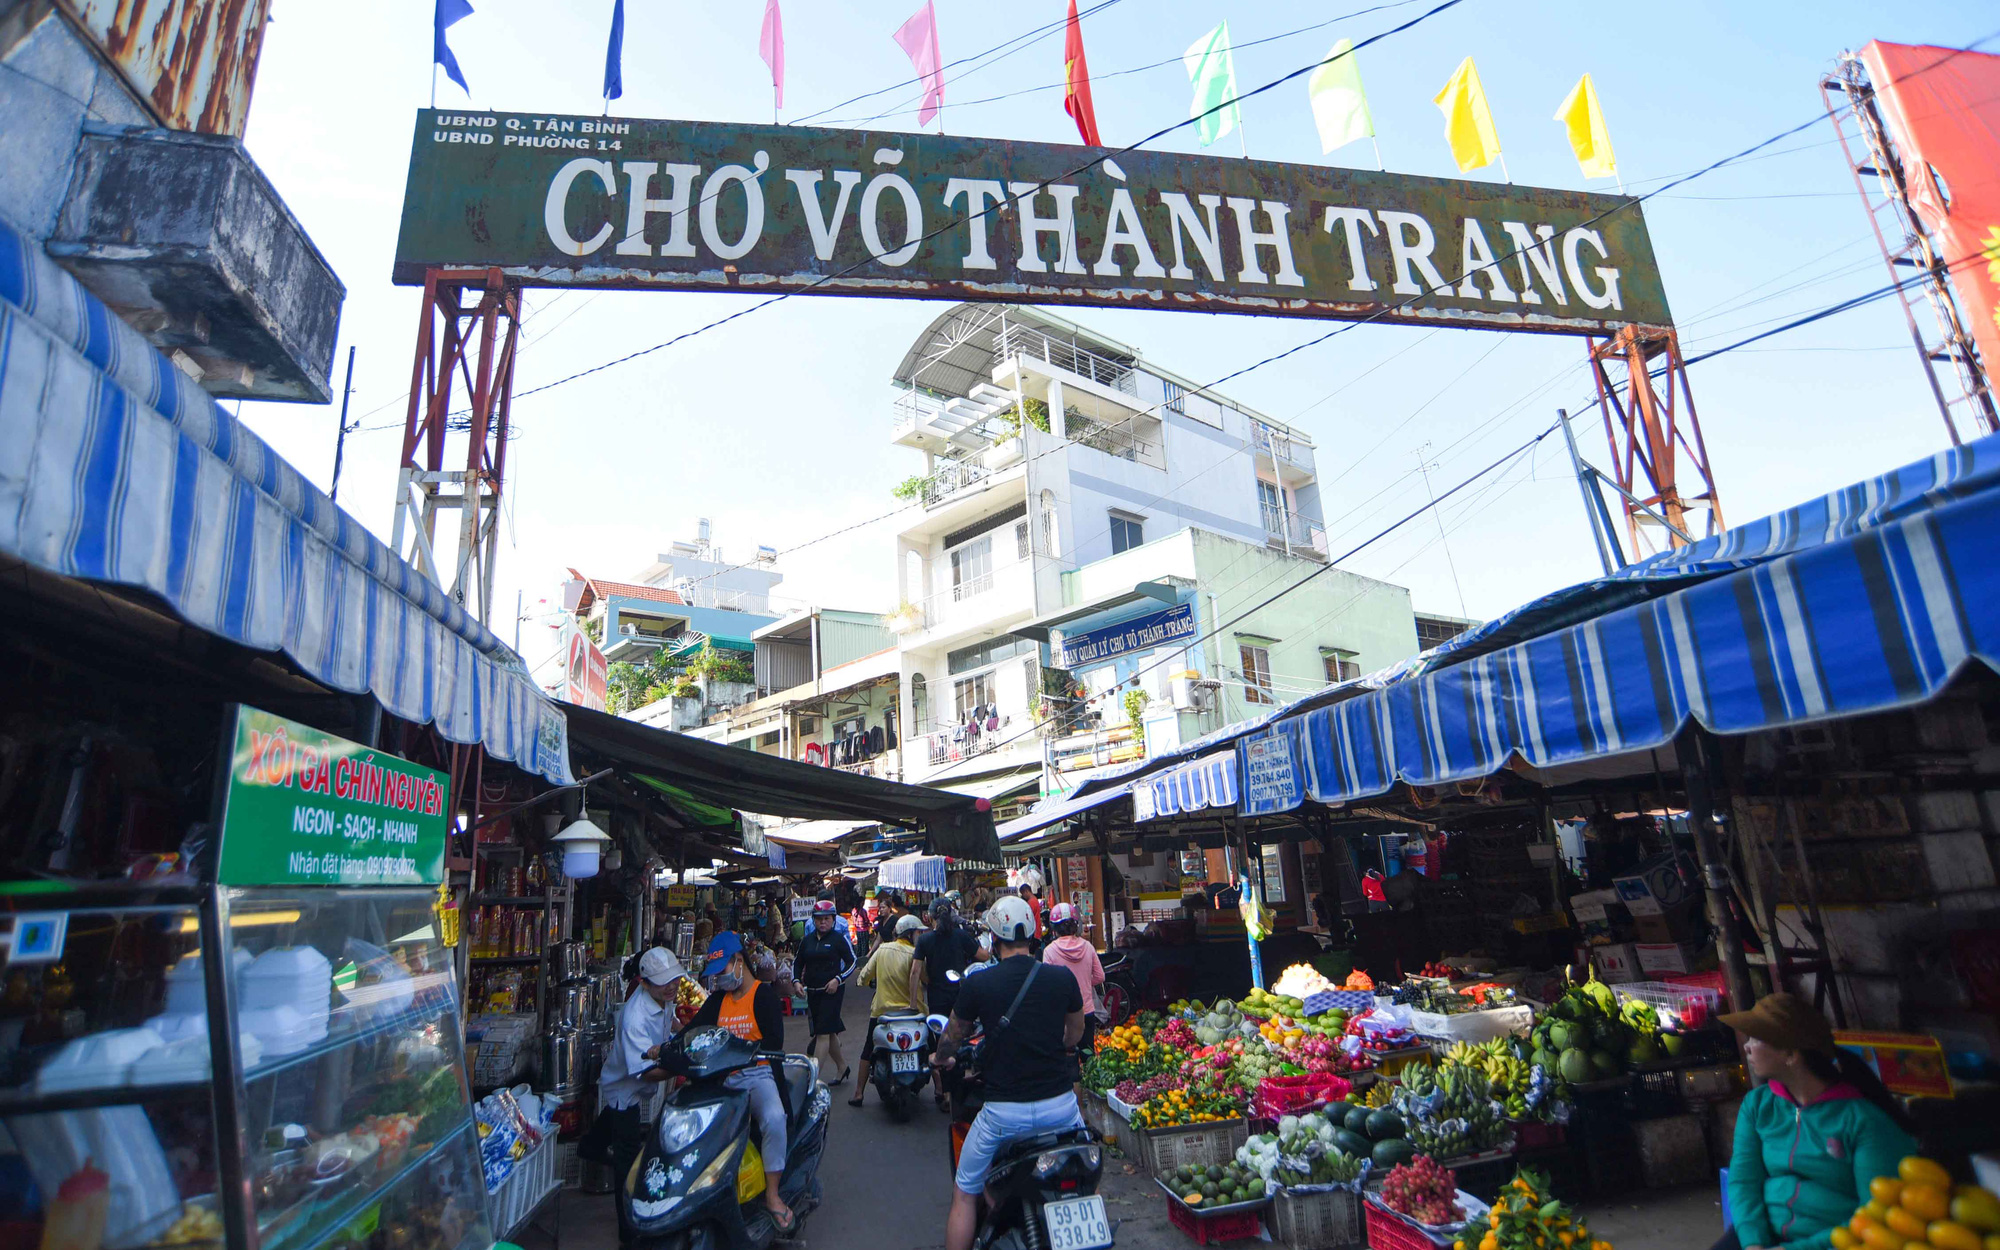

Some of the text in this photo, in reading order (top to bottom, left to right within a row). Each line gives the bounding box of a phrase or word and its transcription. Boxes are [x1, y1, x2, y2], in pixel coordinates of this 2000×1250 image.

[434, 131, 623, 151] UBND PHƯỜNG 14
[437, 115, 630, 135] UBND Q. TÂN BÌNH
[786, 148, 924, 267] VÕ
[943, 158, 1304, 288] THÀNH
[1324, 205, 1622, 311] TRANG
[1064, 648, 1079, 665] BAN
[1098, 636, 1108, 656] LÝ
[1137, 624, 1165, 645] THÀNH
[1165, 616, 1193, 637] TRANG
[244, 726, 444, 816] XÔI GÀ CHÍN NGUYÊN
[293, 805, 335, 836] NGON
[343, 813, 376, 846] SẠCH
[383, 819, 418, 844] NHANH
[289, 850, 319, 879] Nhận
[321, 852, 338, 879] đặt
[1053, 1220, 1107, 1249] 538.49
